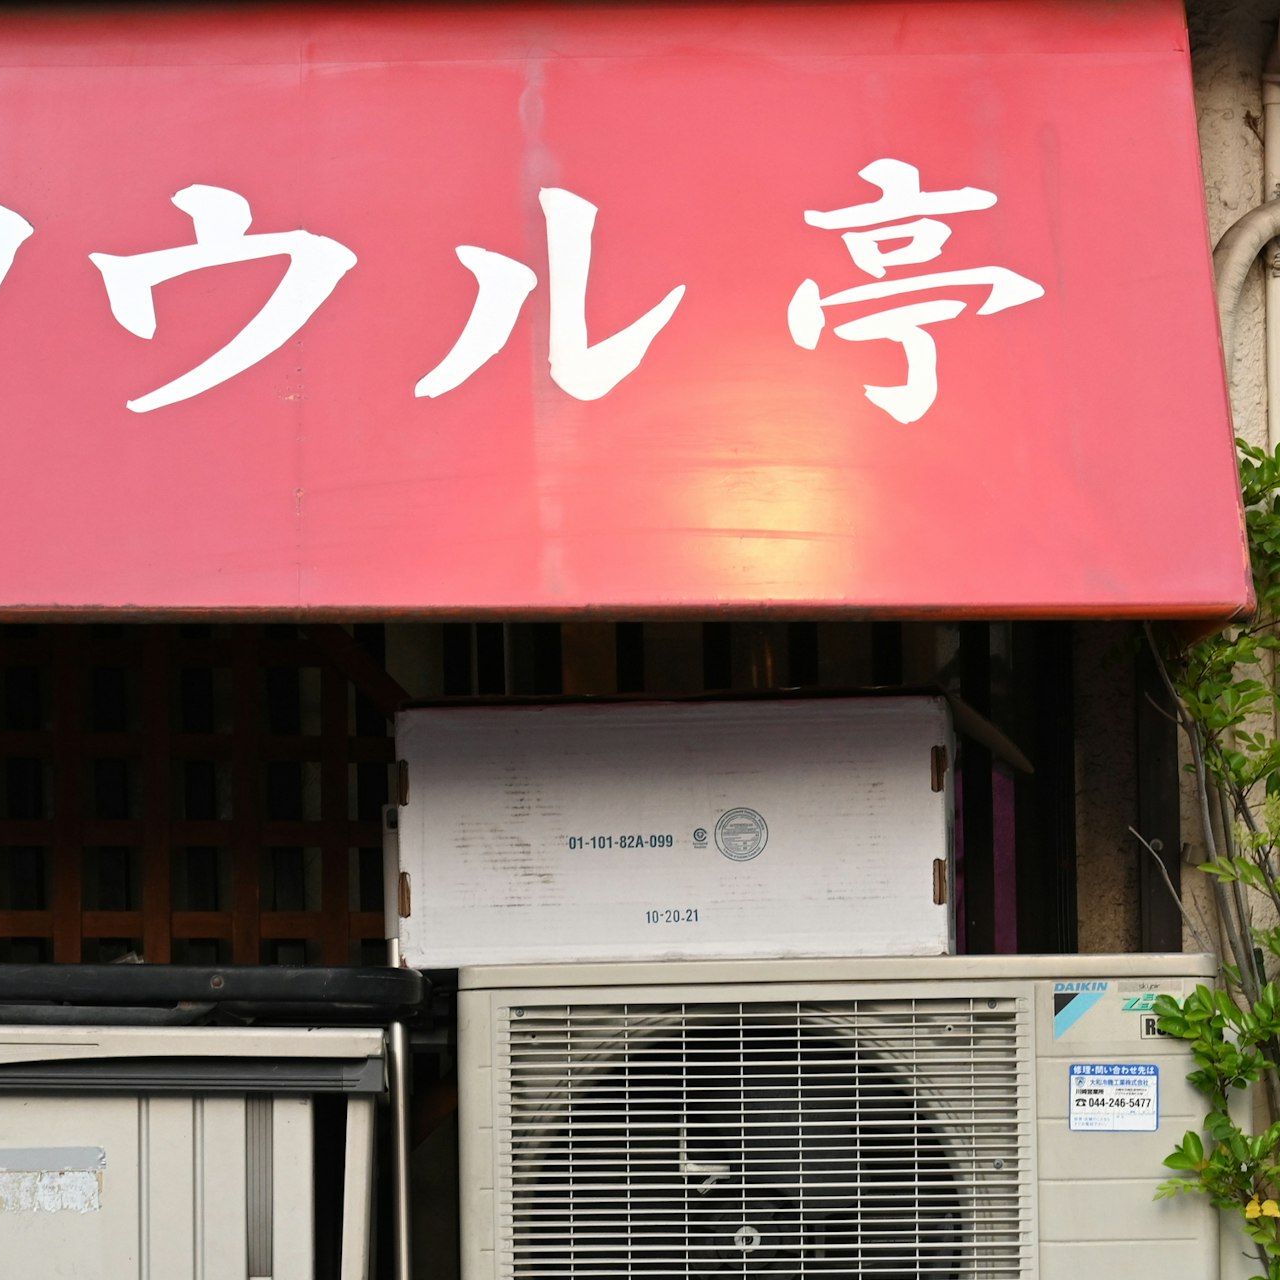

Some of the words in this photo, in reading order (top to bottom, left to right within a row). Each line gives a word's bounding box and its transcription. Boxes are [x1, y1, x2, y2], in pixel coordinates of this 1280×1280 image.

[568, 833, 674, 851] 01-101-82A-099
[645, 908, 700, 924] 10-20-21
[1054, 982, 1108, 992] DAIKIN
[1088, 1097, 1152, 1108] 044-246-5477
